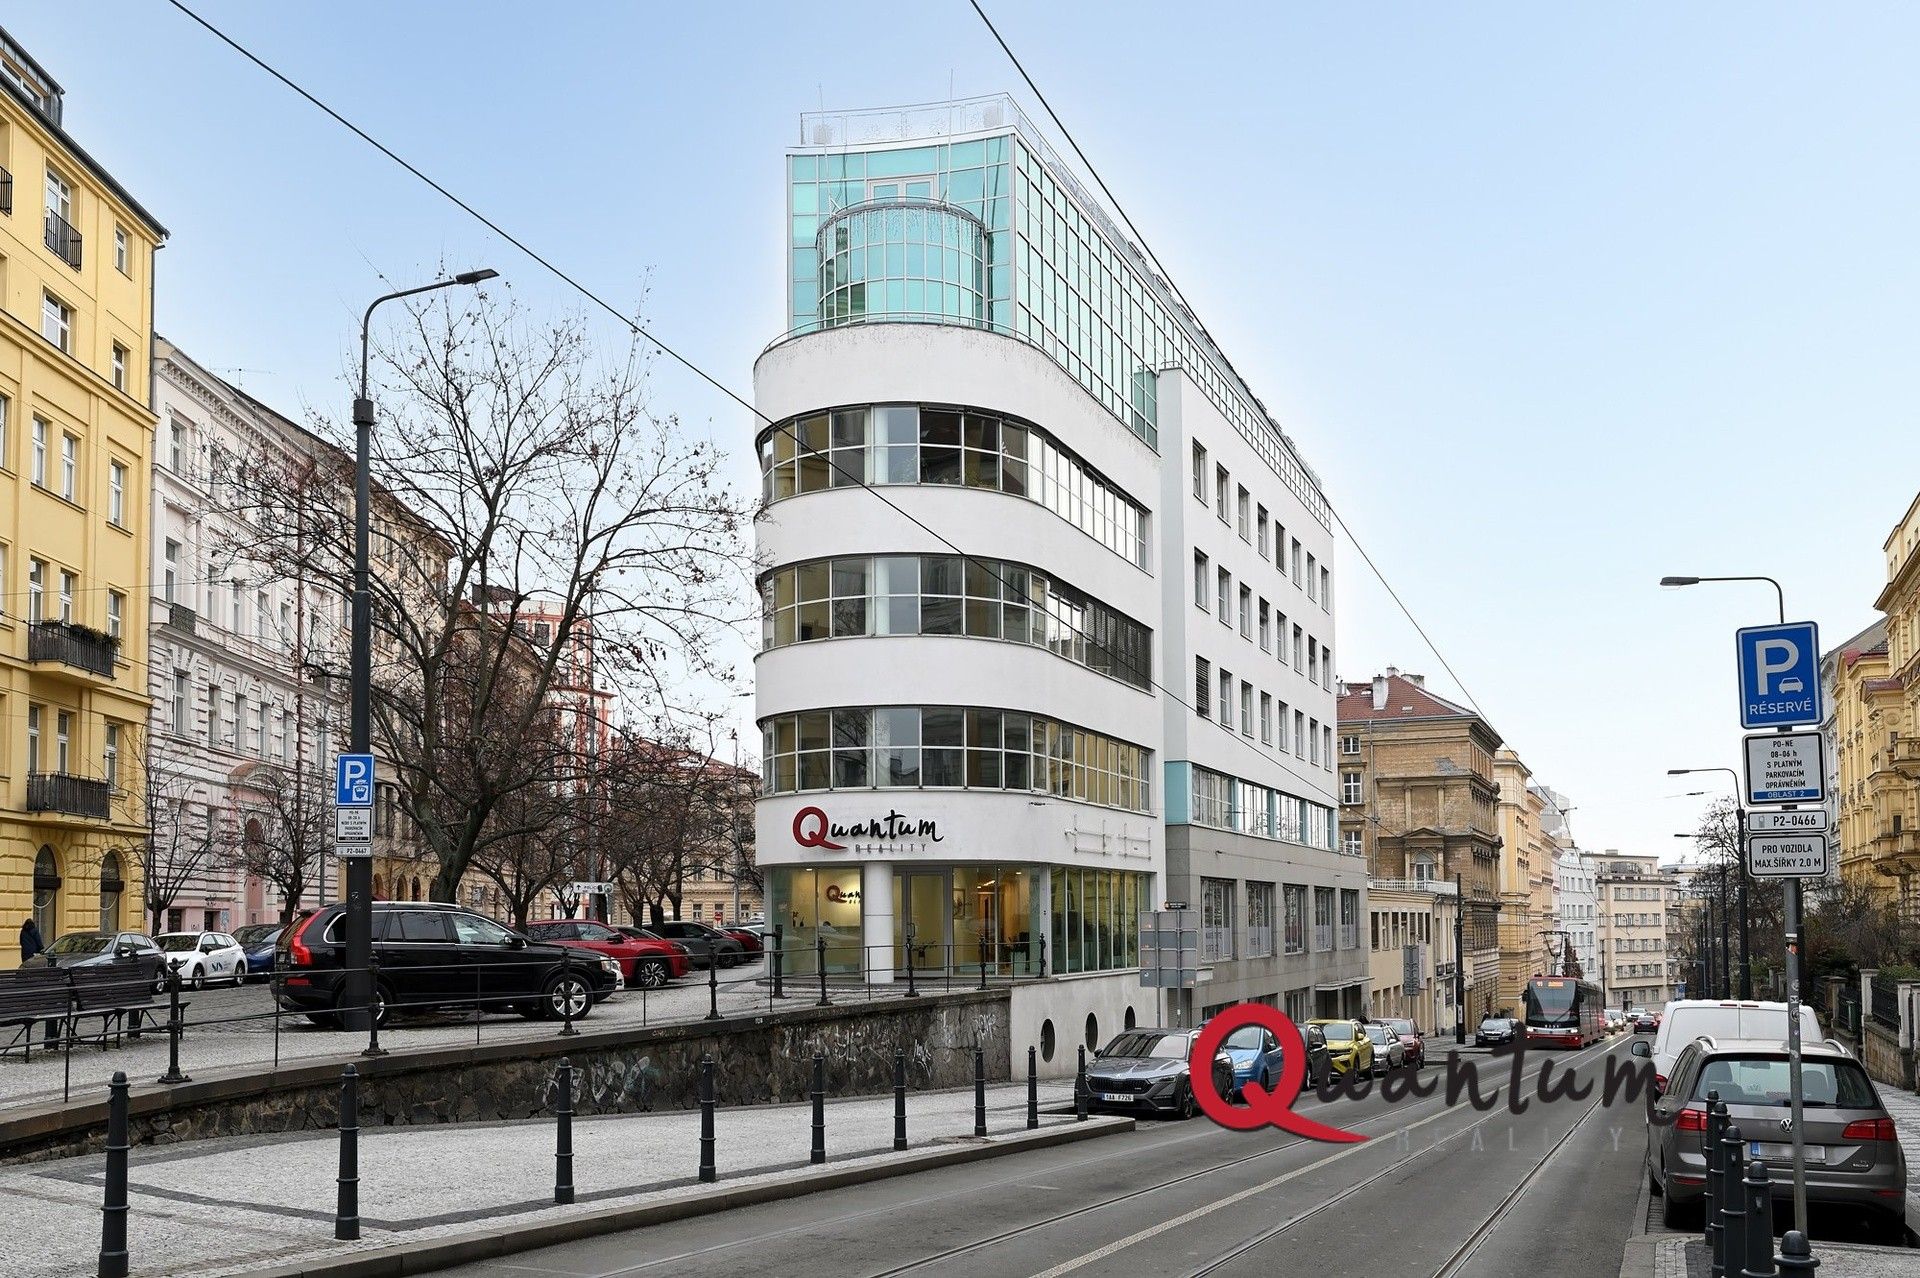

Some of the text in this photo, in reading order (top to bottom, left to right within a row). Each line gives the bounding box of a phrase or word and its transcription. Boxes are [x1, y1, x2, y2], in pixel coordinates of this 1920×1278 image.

[1755, 638, 1799, 695] P
[1749, 697, 1812, 715] RÉSERVÉ
[1770, 750, 1790, 758] 08-06
[1774, 758, 1802, 768] PLATNÝM
[345, 761, 366, 789] P
[1765, 768, 1805, 778] PARKOVACÍM
[1773, 815, 1816, 826] P2-0466
[792, 806, 944, 850] Quantum
[855, 844, 926, 853] REALITY
[1762, 844, 1813, 853] PRO VOZIDLA
[1814, 858, 1821, 867] M
